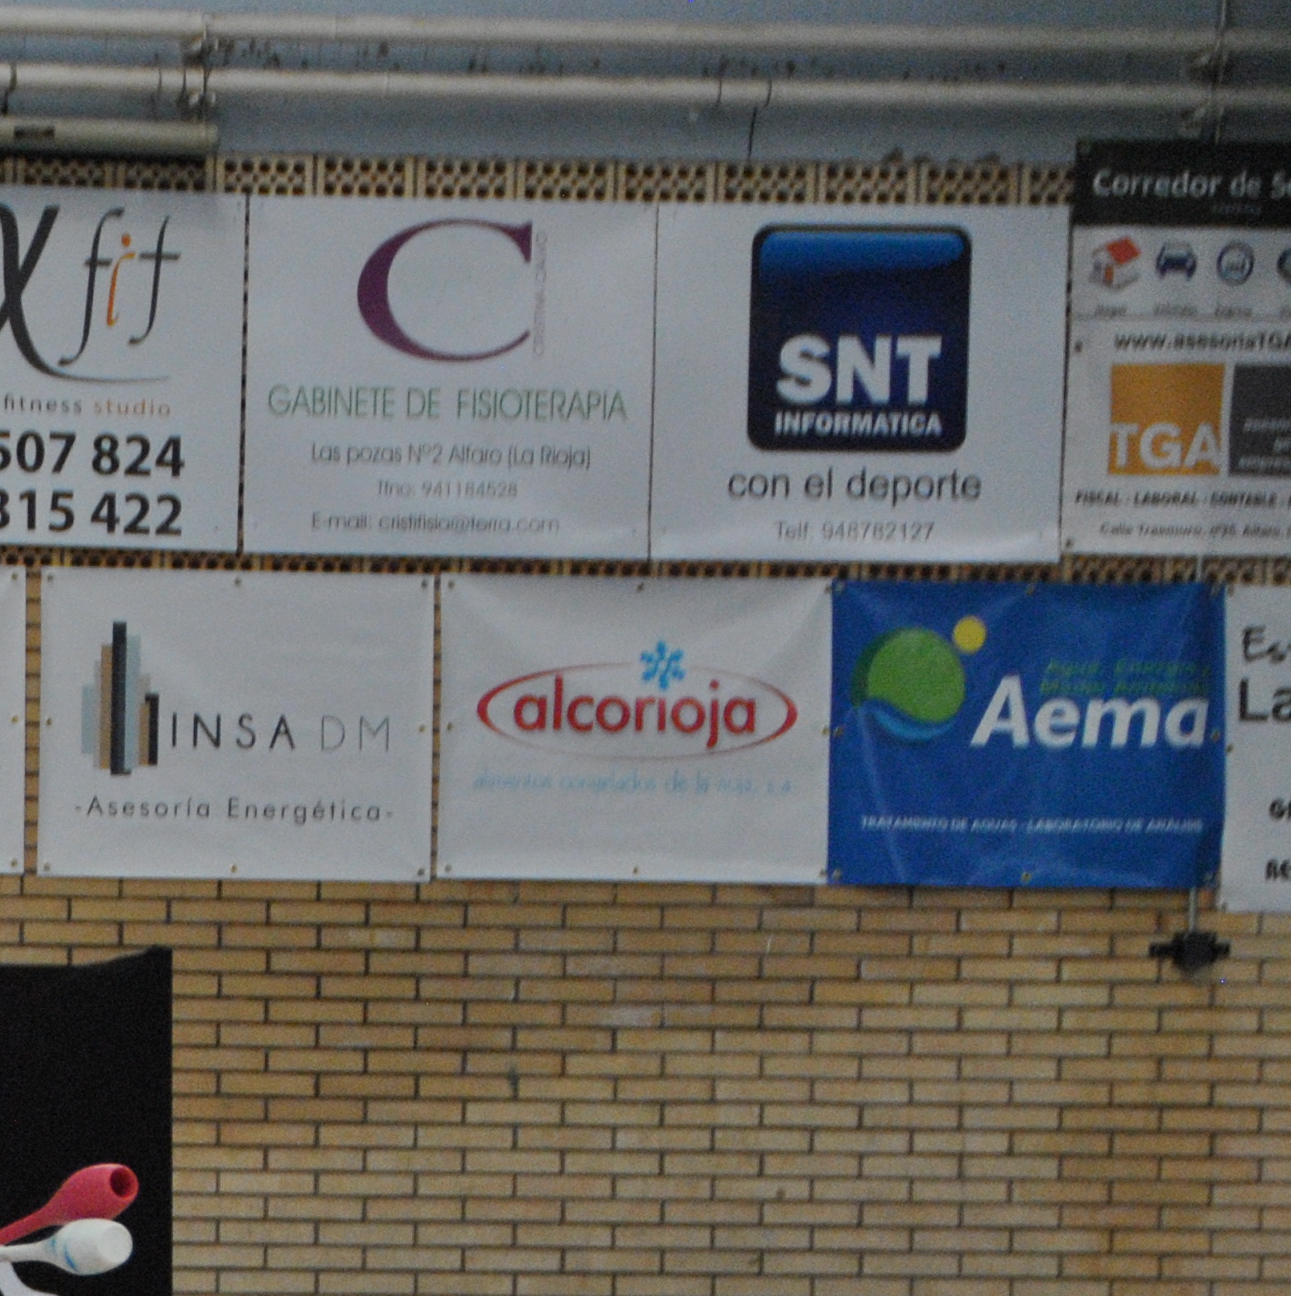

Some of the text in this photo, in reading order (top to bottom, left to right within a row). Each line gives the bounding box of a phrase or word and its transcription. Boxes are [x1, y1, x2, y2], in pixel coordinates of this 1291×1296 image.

[1093, 168, 1222, 197] Corredor
[1230, 169, 1262, 197] de
[776, 335, 942, 406] SNT
[3, 393, 82, 414] fitness
[93, 397, 171, 417] studio
[267, 384, 395, 419] GABINETE
[406, 387, 441, 419] DE
[774, 411, 942, 437] INFORMATICA
[92, 433, 185, 477] 824
[312, 442, 340, 463] Las
[346, 446, 402, 467] pozas
[449, 445, 502, 465] Alfaro
[1110, 422, 1219, 470] TGA
[728, 467, 982, 507] con el deporte
[90, 492, 182, 535] 422
[513, 674, 756, 748] alcorioja
[971, 674, 1209, 749] Aema
[172, 712, 391, 751] INSA DM
